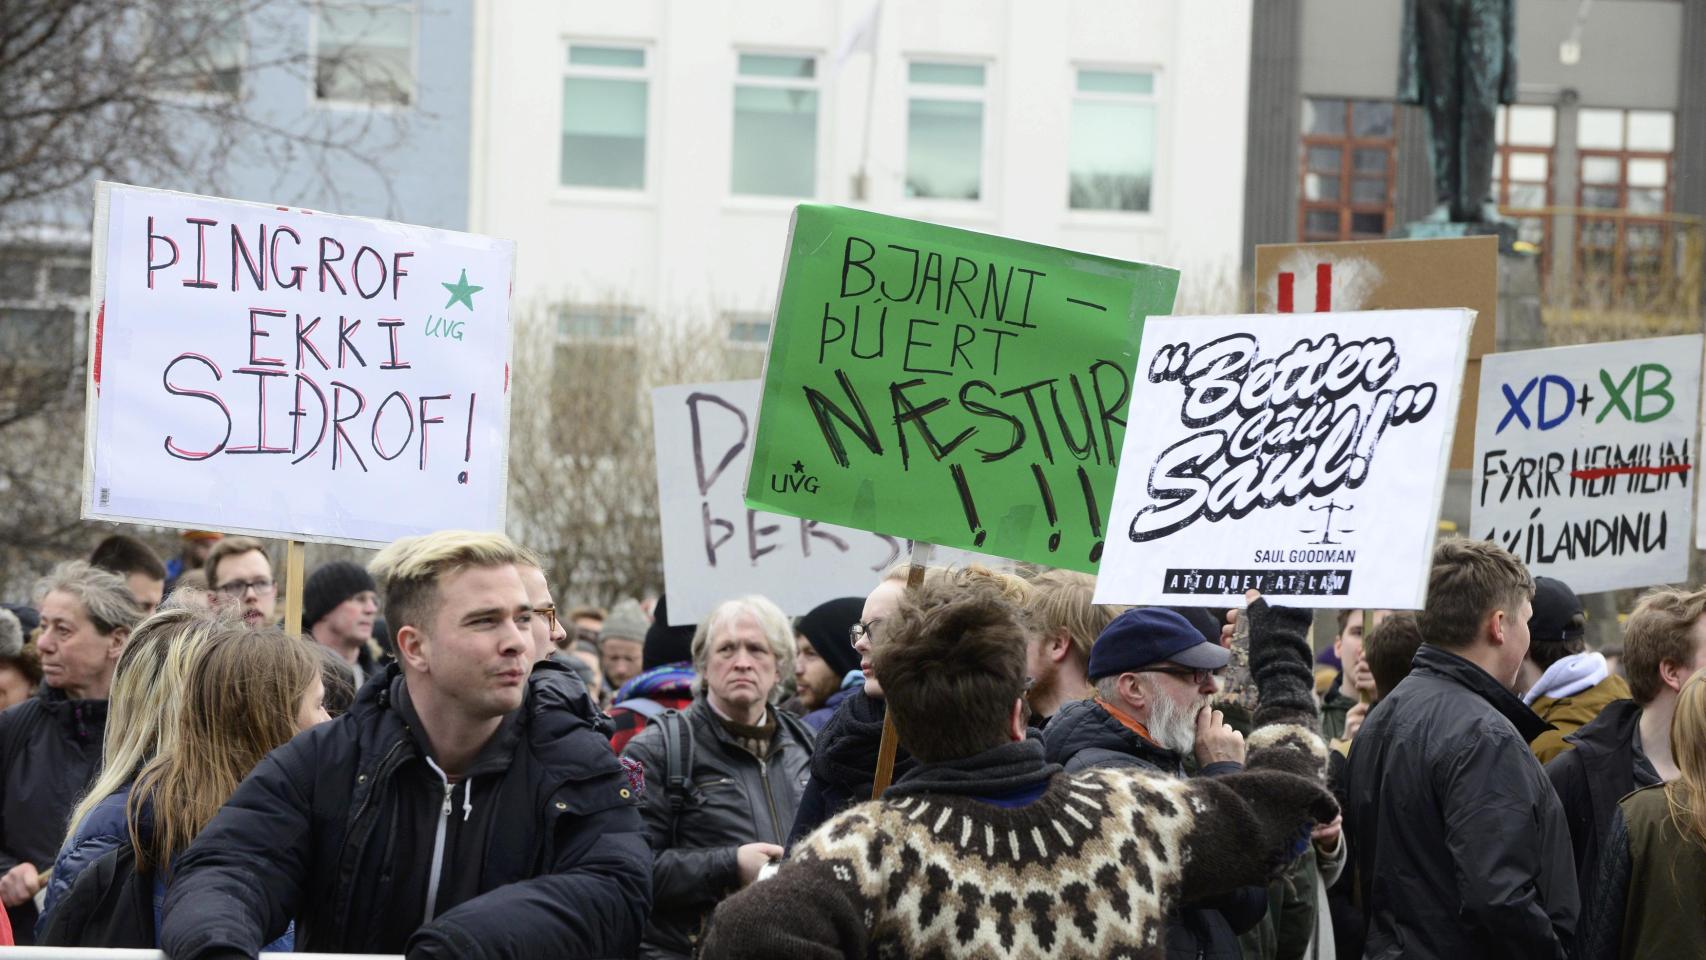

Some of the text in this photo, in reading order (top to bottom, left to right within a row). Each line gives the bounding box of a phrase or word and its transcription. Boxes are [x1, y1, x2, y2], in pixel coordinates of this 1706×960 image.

[147, 217, 415, 300] ÞINGROF
[839, 236, 1048, 329] BJARNI
[248, 307, 412, 371] EKKI
[424, 314, 466, 341] UVG
[902, 317, 1020, 376] ERT
[802, 358, 1130, 472] NÆSTUR
[1226, 397, 1337, 464] Call
[771, 474, 821, 495] UVG
[1480, 449, 1565, 507] FYRIR
[1170, 574, 1346, 591] ATTORNEY AT LAW
[1254, 549, 1356, 563] SAUL GOODMAN
